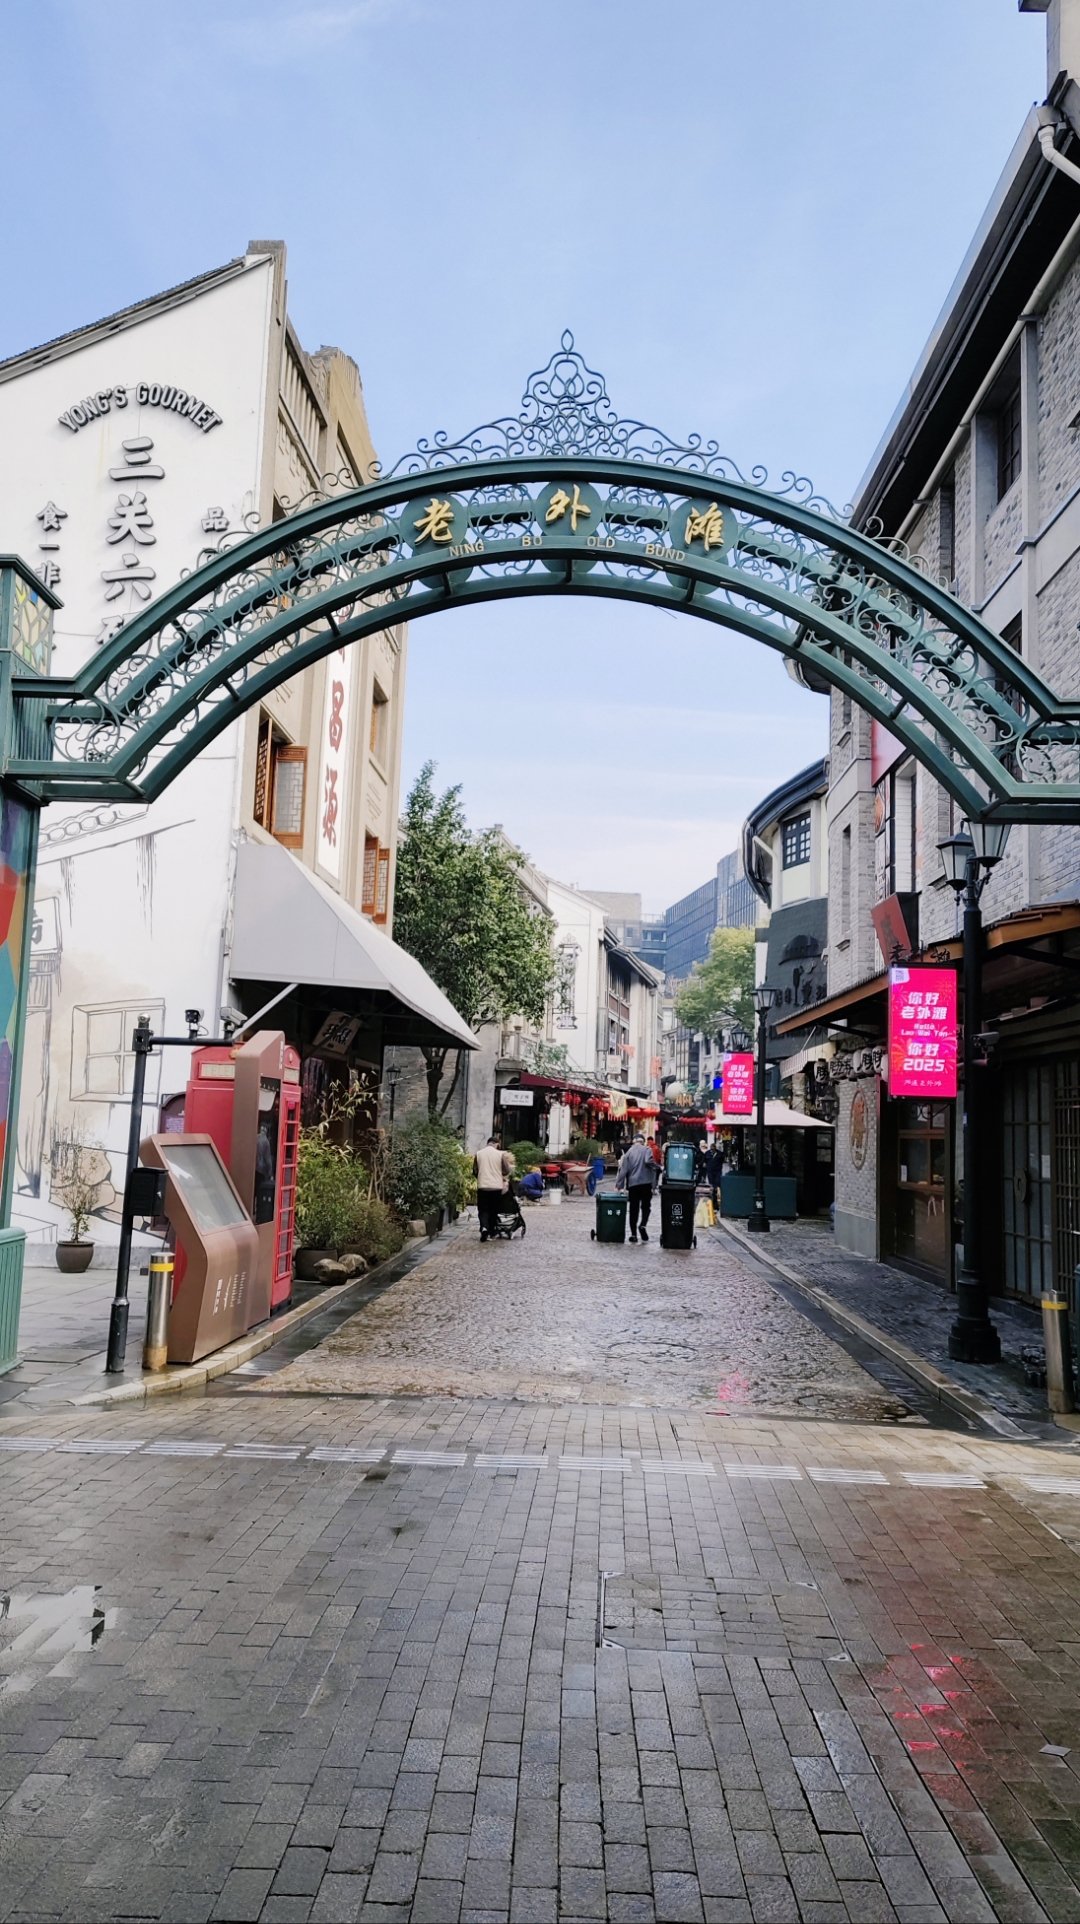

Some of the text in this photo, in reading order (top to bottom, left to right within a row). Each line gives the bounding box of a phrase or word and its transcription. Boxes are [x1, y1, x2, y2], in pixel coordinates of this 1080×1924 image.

[58, 382, 223, 433] YONG'S GOURMET
[449, 536, 686, 562] NING BO OLD BUND
[908, 992, 939, 1005] 你好
[901, 1006, 947, 1019] 老外滩
[908, 1043, 939, 1056] 你好
[203, 1065, 236, 1077] TELE
[903, 1058, 945, 1071] 2025
